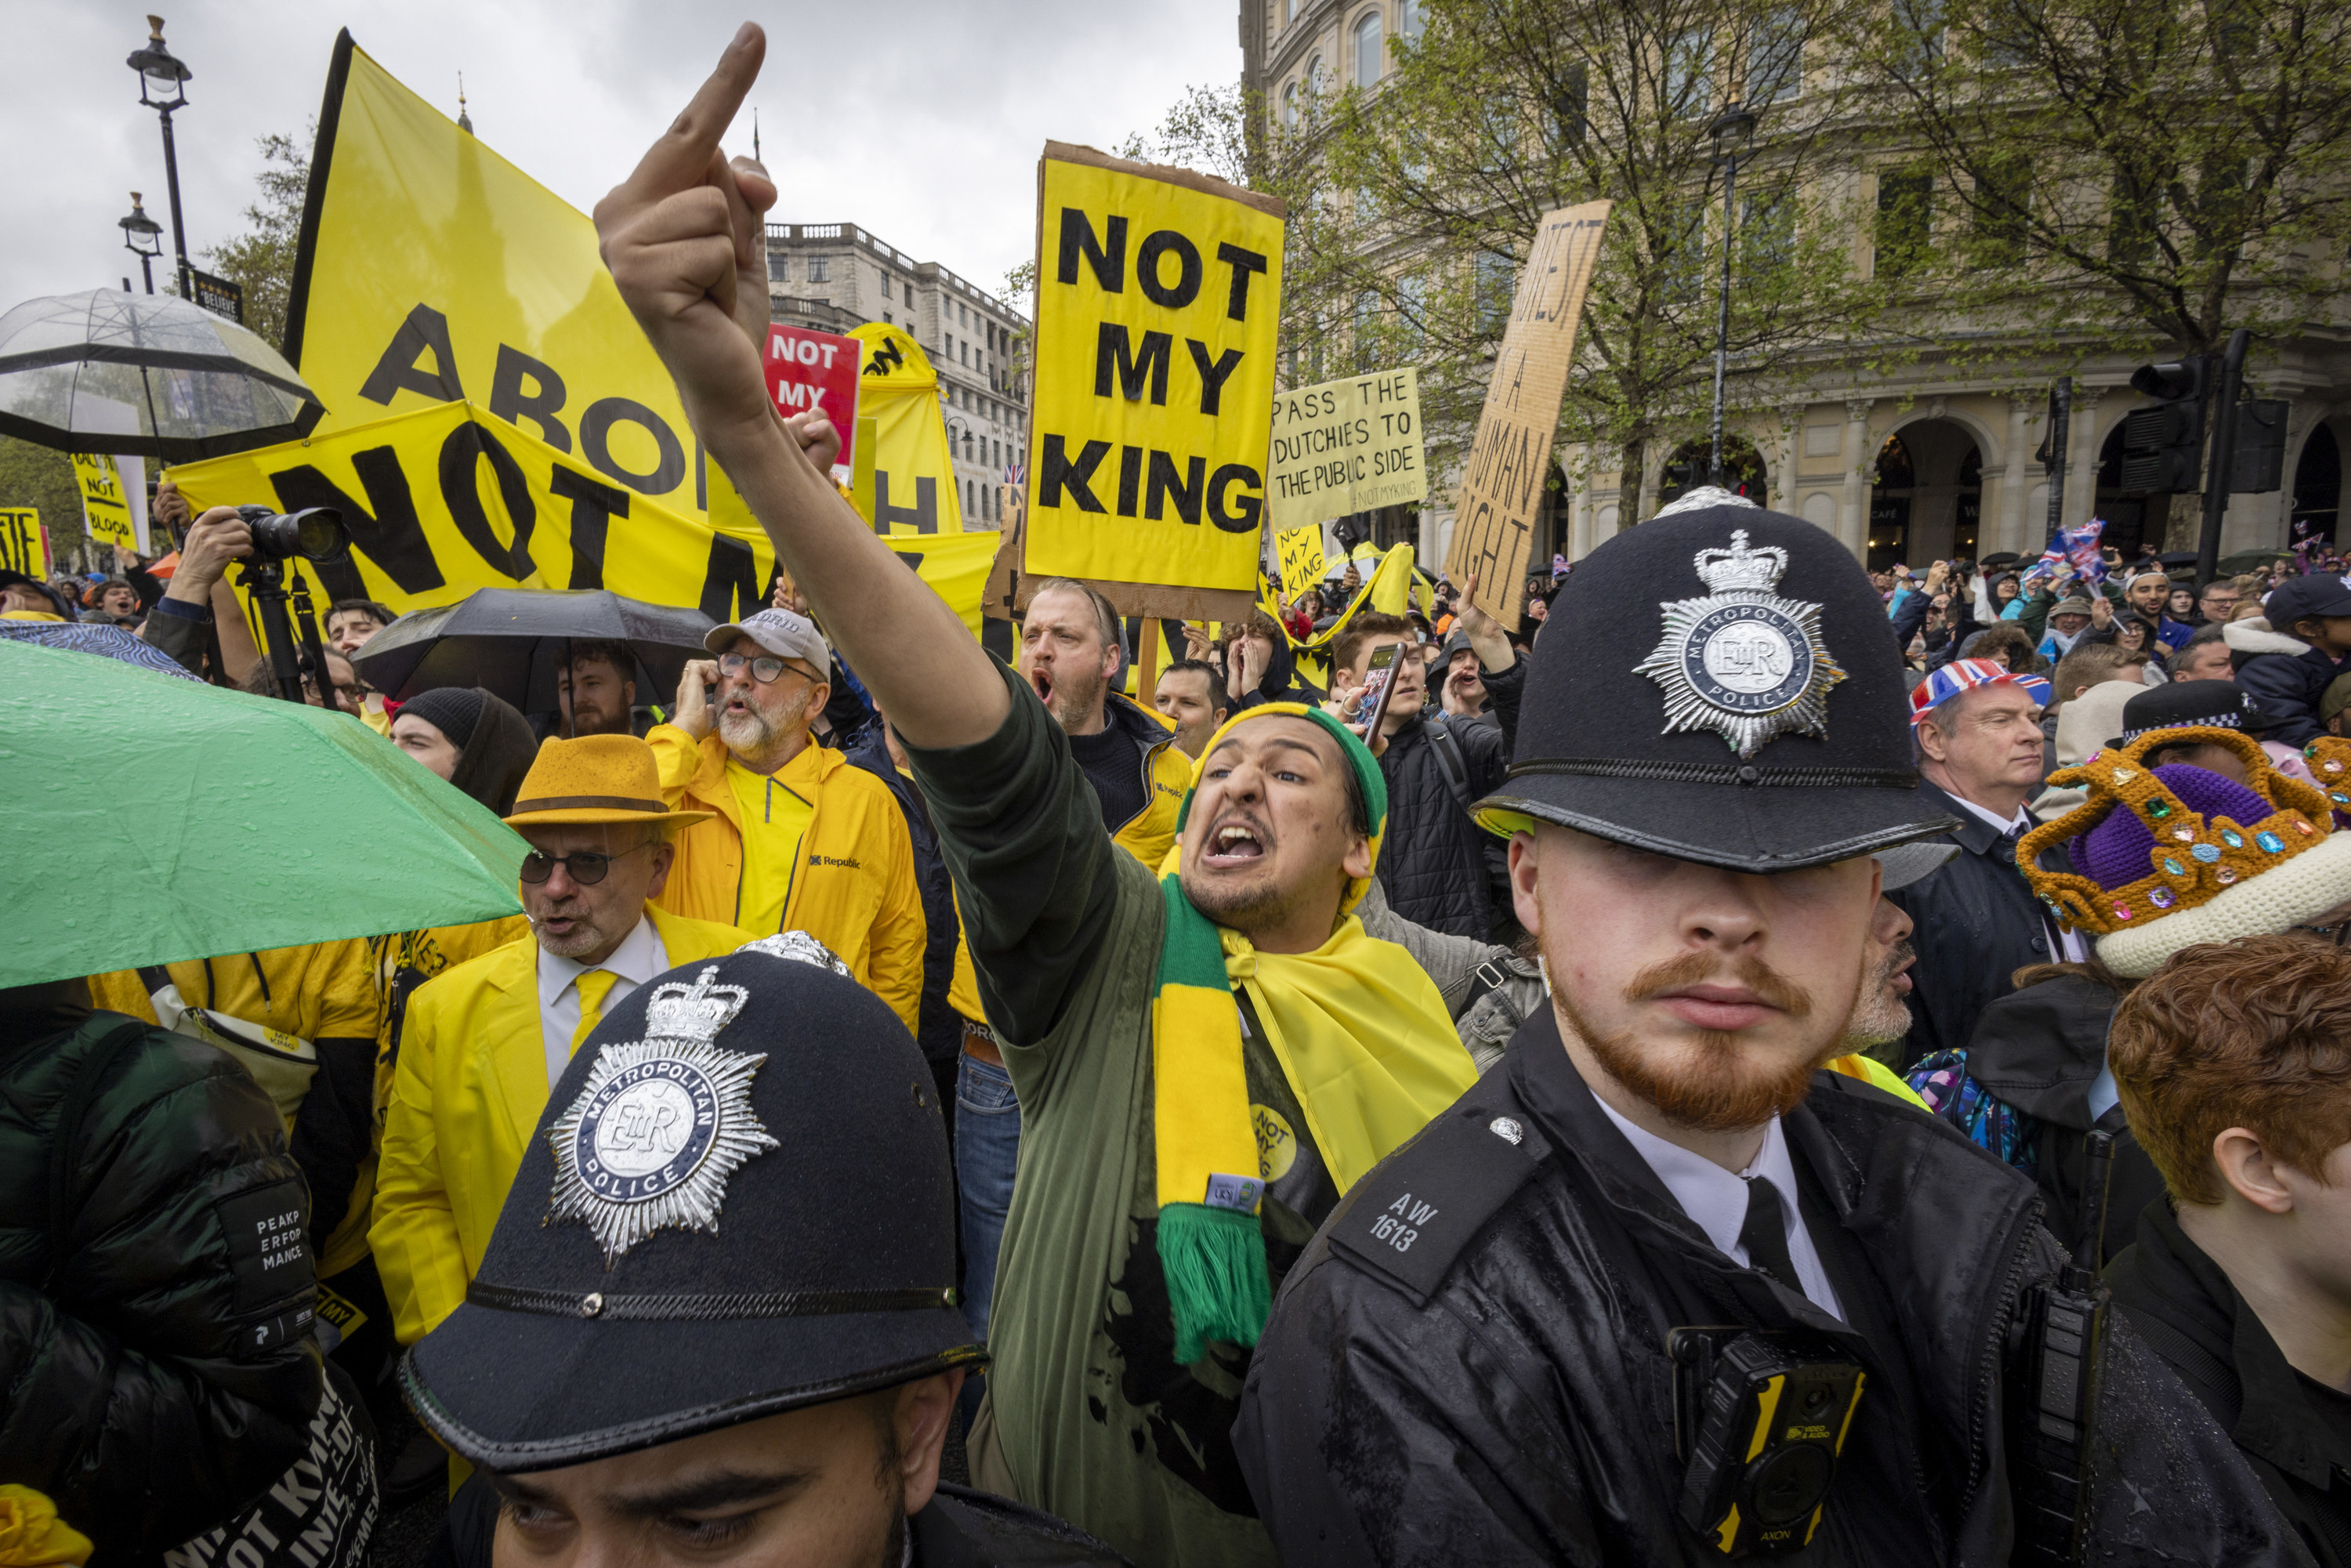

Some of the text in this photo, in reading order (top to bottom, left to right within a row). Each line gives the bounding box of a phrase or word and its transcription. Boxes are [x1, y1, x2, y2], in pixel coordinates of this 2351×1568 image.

[1057, 207, 1267, 322] NOT
[772, 334, 839, 370] NOT
[1094, 321, 1245, 417] MY
[778, 379, 827, 408] MY
[1271, 375, 1407, 427] PASS THE
[1274, 411, 1411, 465] DUTCHIES TO
[1038, 433, 1263, 534] KING
[1276, 445, 1415, 498] THE PUBLIC SIDE
[1468, 415, 1545, 516] HUMAN
[86, 477, 114, 497] NOT
[1353, 480, 1417, 509] #NOTMYKING
[89, 512, 129, 536] BLOOD
[270, 420, 630, 601] NOT
[1284, 535, 1314, 573] MY
[1451, 486, 1529, 610] RIGHT
[1288, 552, 1323, 598] KING
[1687, 607, 1806, 661] METROPOLITAN
[1708, 686, 1789, 706] POLICE
[824, 856, 860, 870] Republic
[587, 1062, 713, 1126] METROPOLITAN
[1256, 1110, 1289, 1144] NOT
[585, 1163, 679, 1196] POLICE
[257, 1210, 299, 1235] PEAKP
[261, 1228, 302, 1252] ERFOR
[1370, 1214, 1418, 1252] 1613
[263, 1245, 302, 1271] MANCE
[322, 1302, 351, 1324] MY
[1760, 1530, 1791, 1541] AXON
